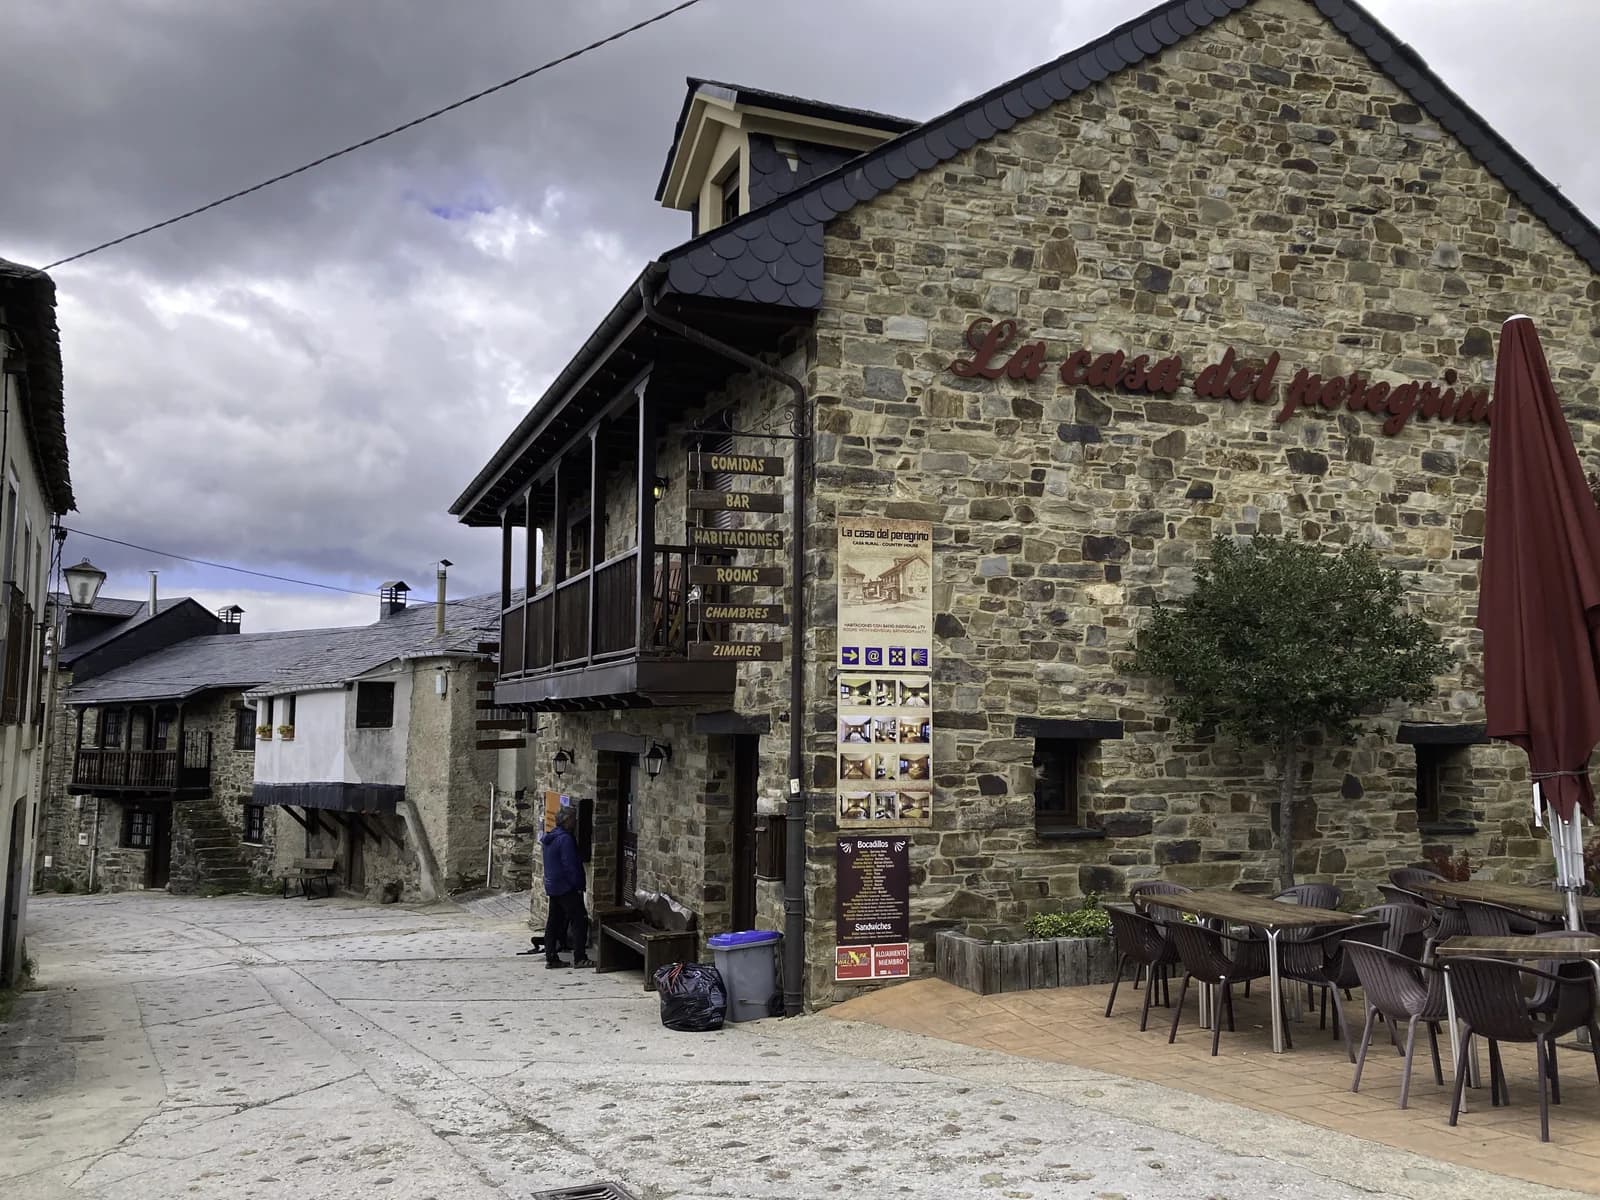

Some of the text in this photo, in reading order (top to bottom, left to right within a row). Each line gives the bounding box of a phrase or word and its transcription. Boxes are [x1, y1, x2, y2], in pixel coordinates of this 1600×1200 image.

[947, 317, 1495, 436] La casa del peregrin
[711, 455, 765, 473] COMIDAS
[726, 493, 750, 509] BAR
[694, 531, 780, 547] HABITACIONES
[842, 527, 929, 542] La casa del peregrino
[717, 567, 759, 583] ROOMS
[705, 606, 769, 620] CHAMBRES
[713, 644, 761, 657] ZIMMER
[857, 840, 889, 849] Bocadillos
